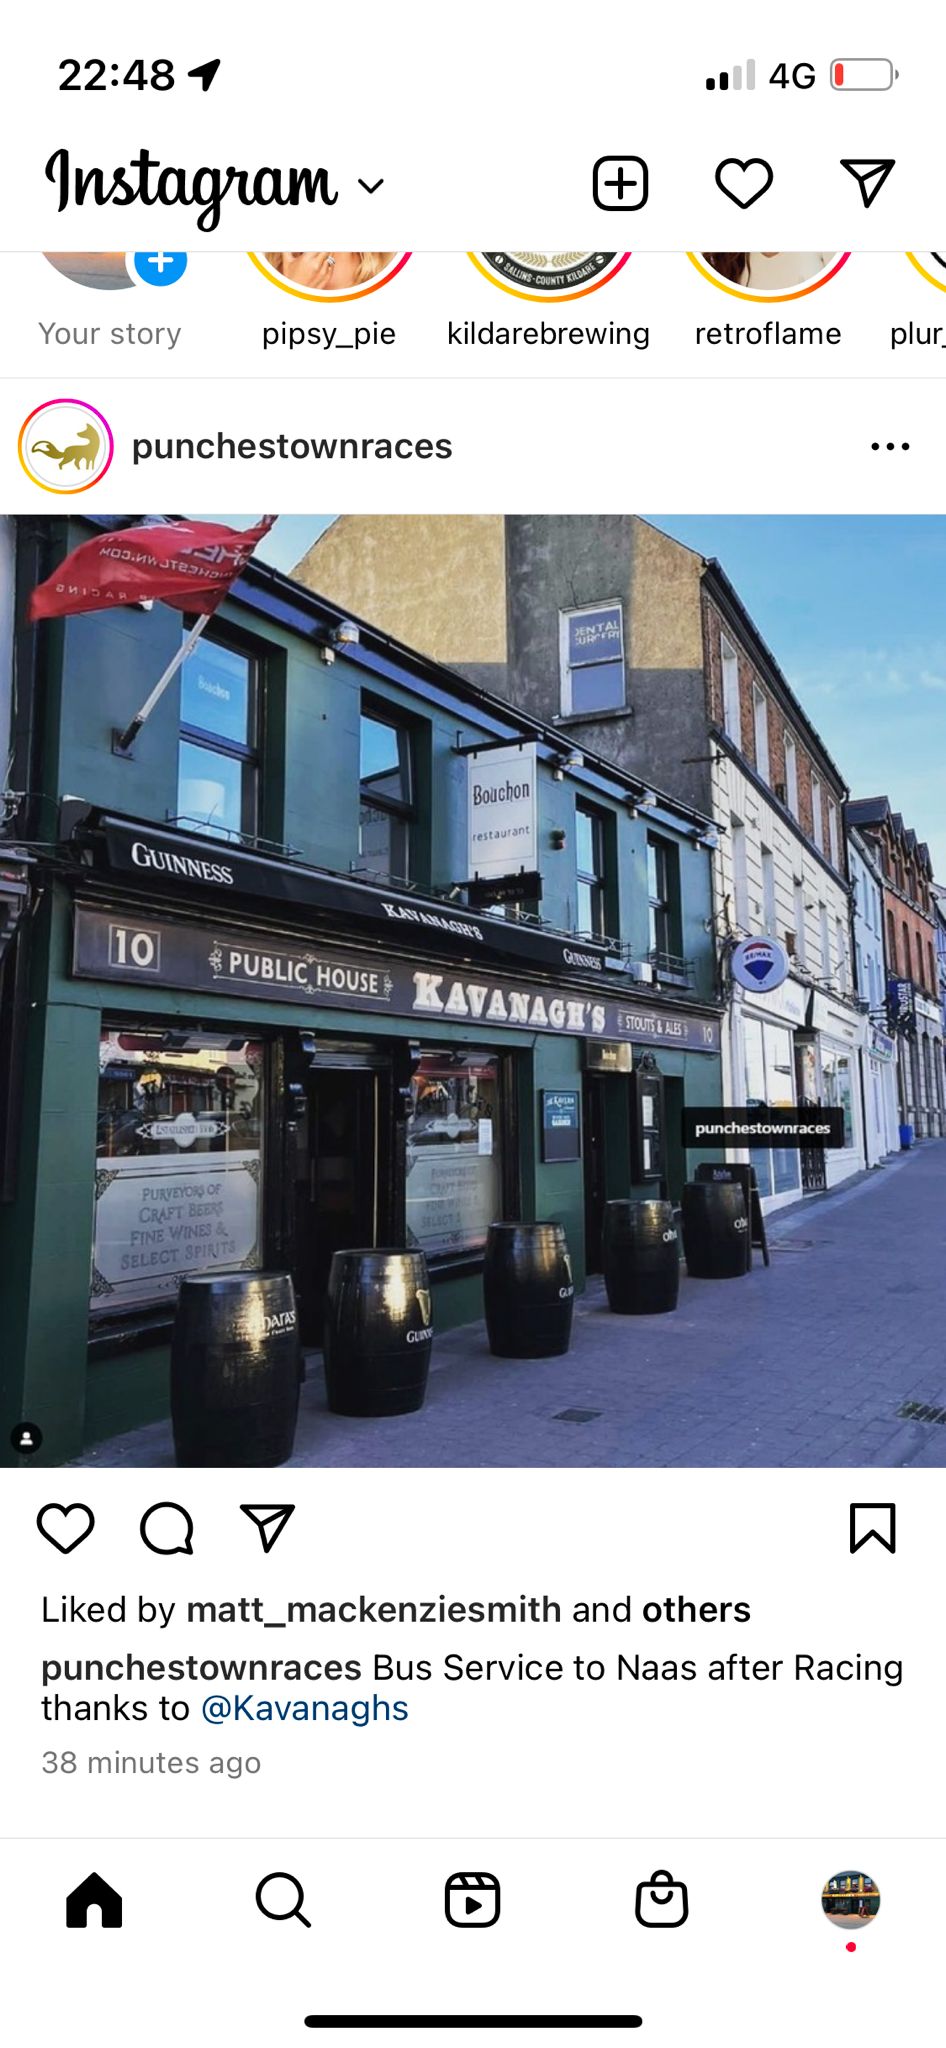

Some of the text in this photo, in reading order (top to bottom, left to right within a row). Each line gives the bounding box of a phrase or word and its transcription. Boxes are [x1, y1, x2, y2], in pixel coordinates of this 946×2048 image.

[58, 58, 176, 92] 22:48
[768, 62, 816, 90] 4G
[44, 148, 339, 233] Instagram
[566, 262, 597, 284] KILDARE
[38, 321, 182, 351] Your story
[263, 320, 396, 351] pipsy_pie
[448, 320, 650, 351] kildarebrewing
[696, 320, 842, 345] retroflame
[133, 431, 453, 466] punchestownraces
[472, 780, 530, 806] Bouchon
[472, 825, 531, 842] restaurant
[131, 841, 234, 885] GUINNESS
[381, 902, 484, 941] KAVANAGH'S
[115, 929, 154, 967] 10
[562, 948, 603, 971] GUINNESS
[229, 951, 379, 994] PUBLIC HOUSE
[411, 971, 606, 1034] KAVANAGH'S
[625, 1015, 683, 1036] STOUTS & ALES
[702, 1026, 713, 1043] 10
[142, 1183, 223, 1201] PURVEYORS OF
[138, 1202, 224, 1224] CRAFT BEERS
[130, 1221, 229, 1248] FINE WINES &
[120, 1240, 237, 1271] SELECT SPIRITS
[42, 1593, 751, 1629] Liked by matt_mackenziesmith and others
[42, 1652, 903, 1688] punchestownraces Bus Service to Naas after Racing
[40, 1693, 409, 1728] thanks to @Kavanaghs
[42, 1749, 261, 1780] 38 minutes ago
